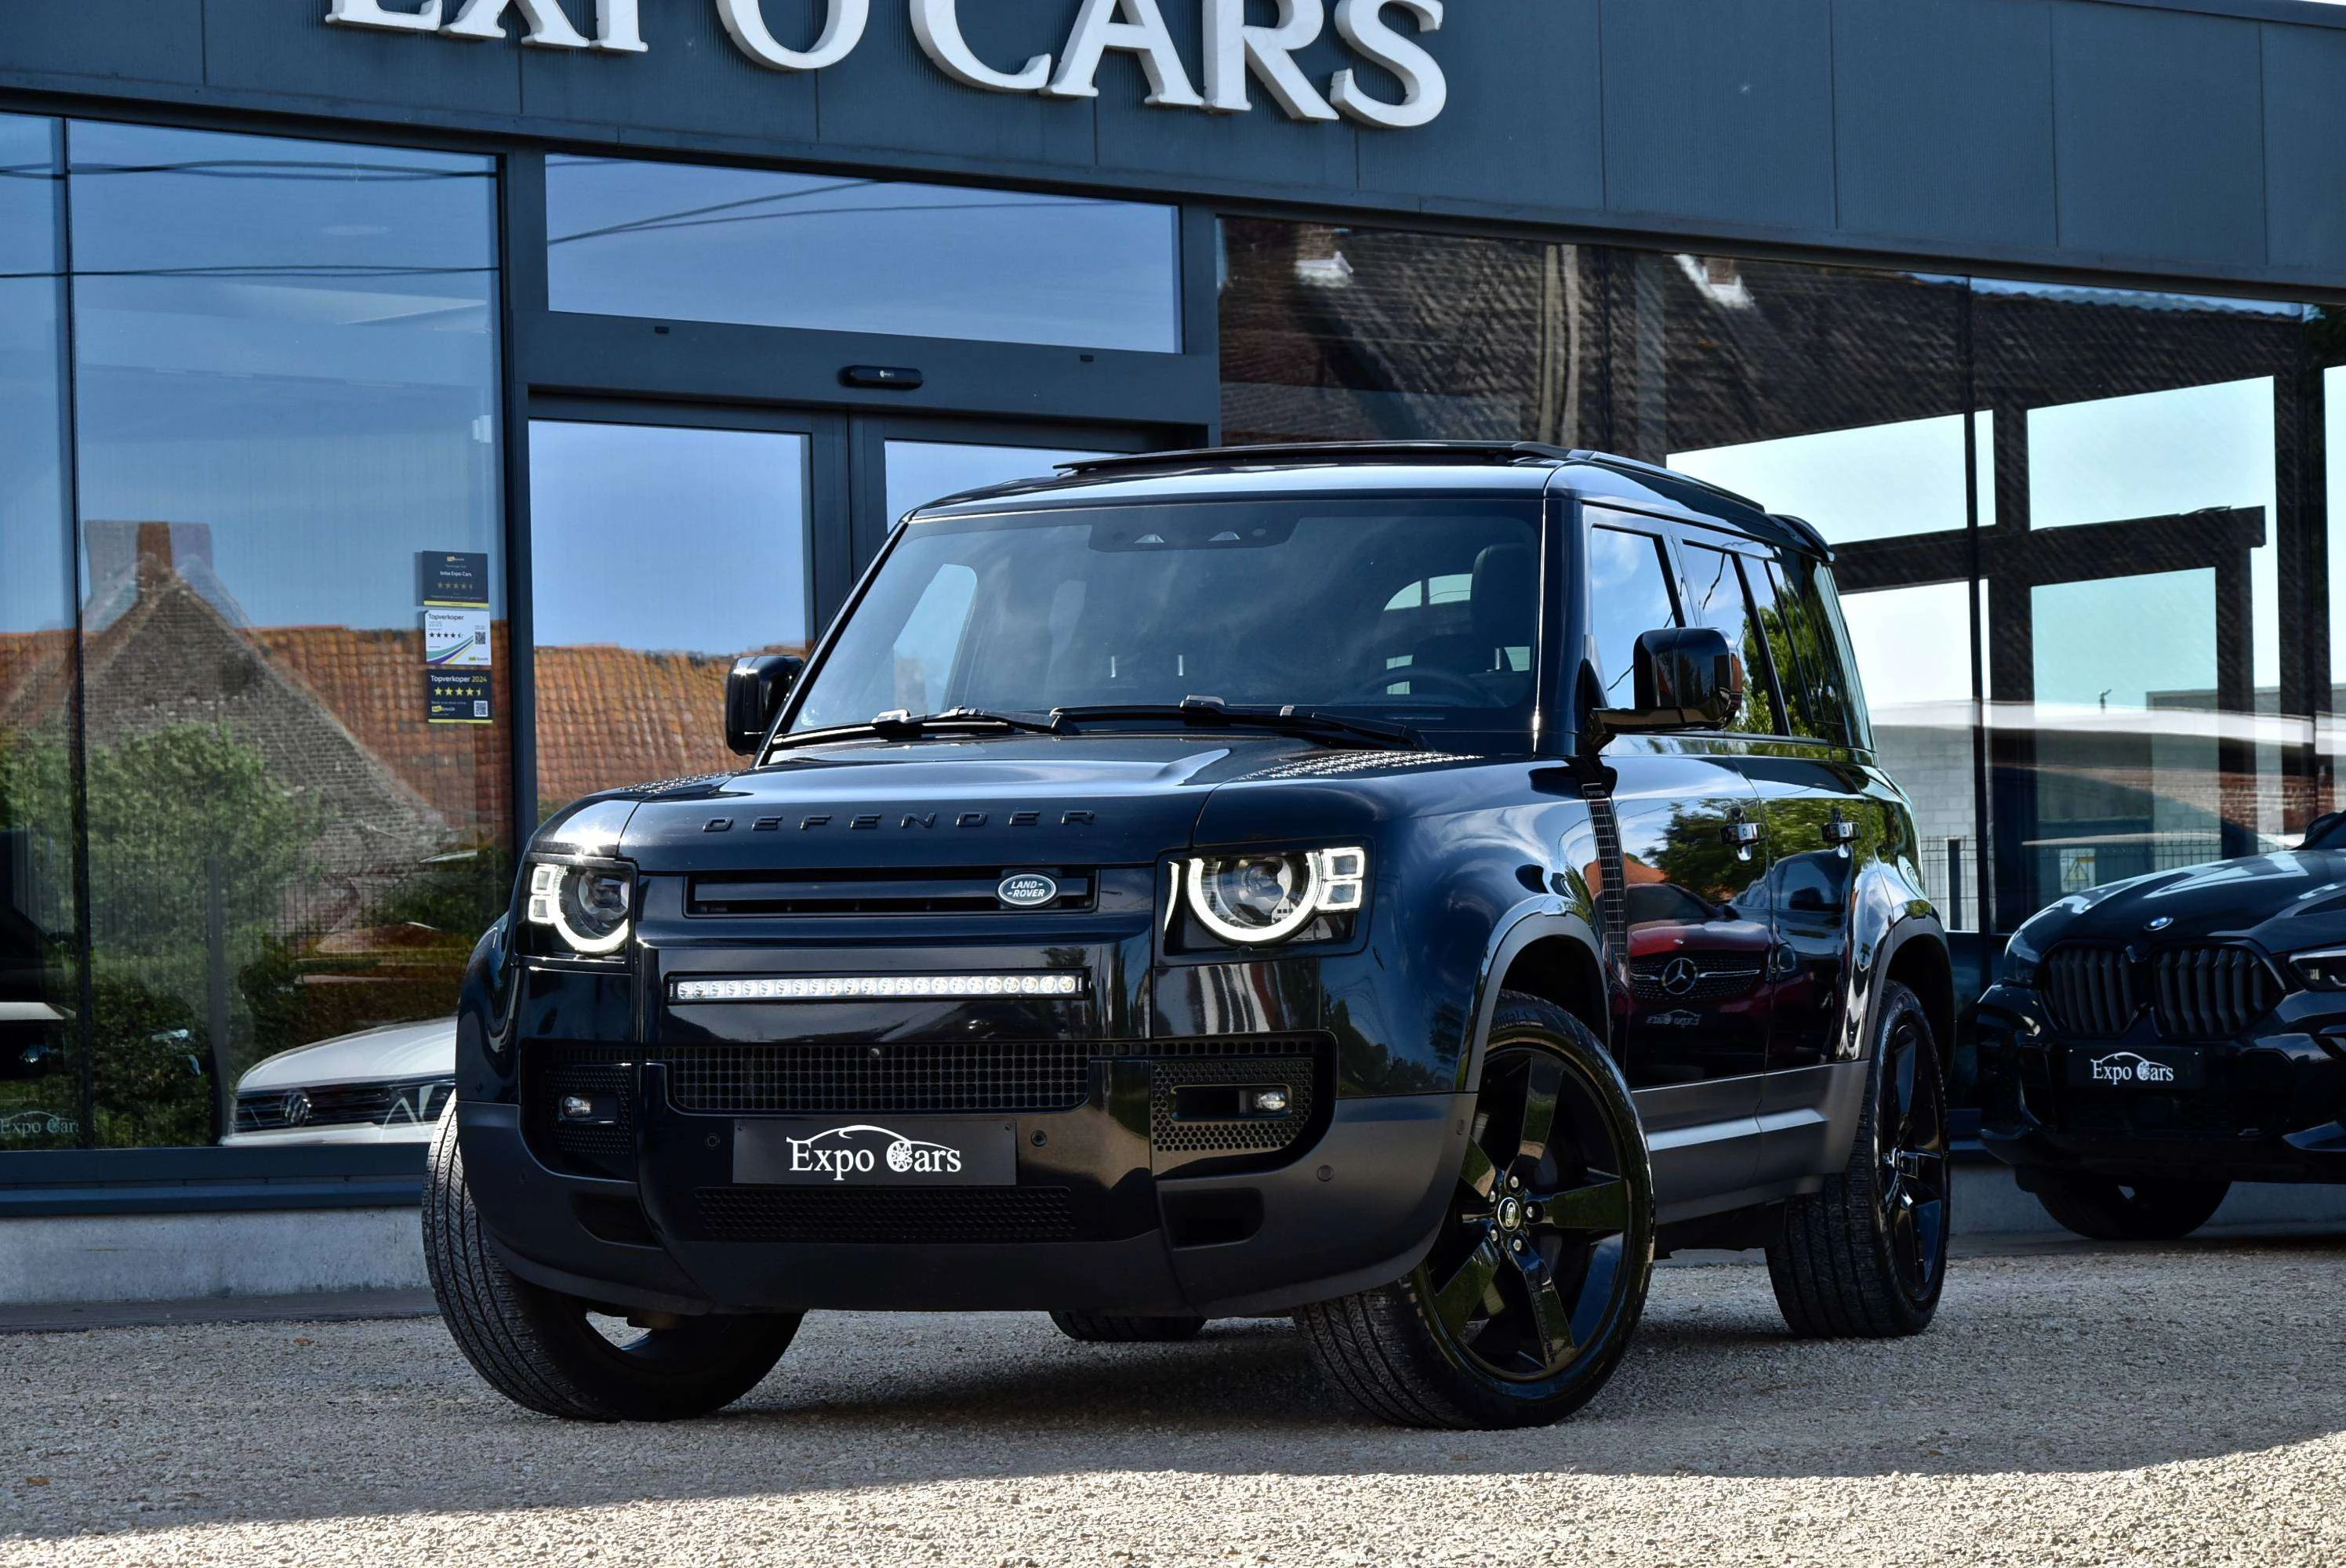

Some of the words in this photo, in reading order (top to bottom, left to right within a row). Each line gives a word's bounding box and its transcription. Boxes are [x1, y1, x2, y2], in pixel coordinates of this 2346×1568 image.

[703, 810, 1095, 833] DEFENDER
[2093, 1060, 2132, 1085] Expo
[2137, 1061, 2174, 1081] Cars
[0, 1118, 41, 1138] Expo
[790, 1141, 875, 1181] Expo
[886, 1141, 961, 1173] Cars
